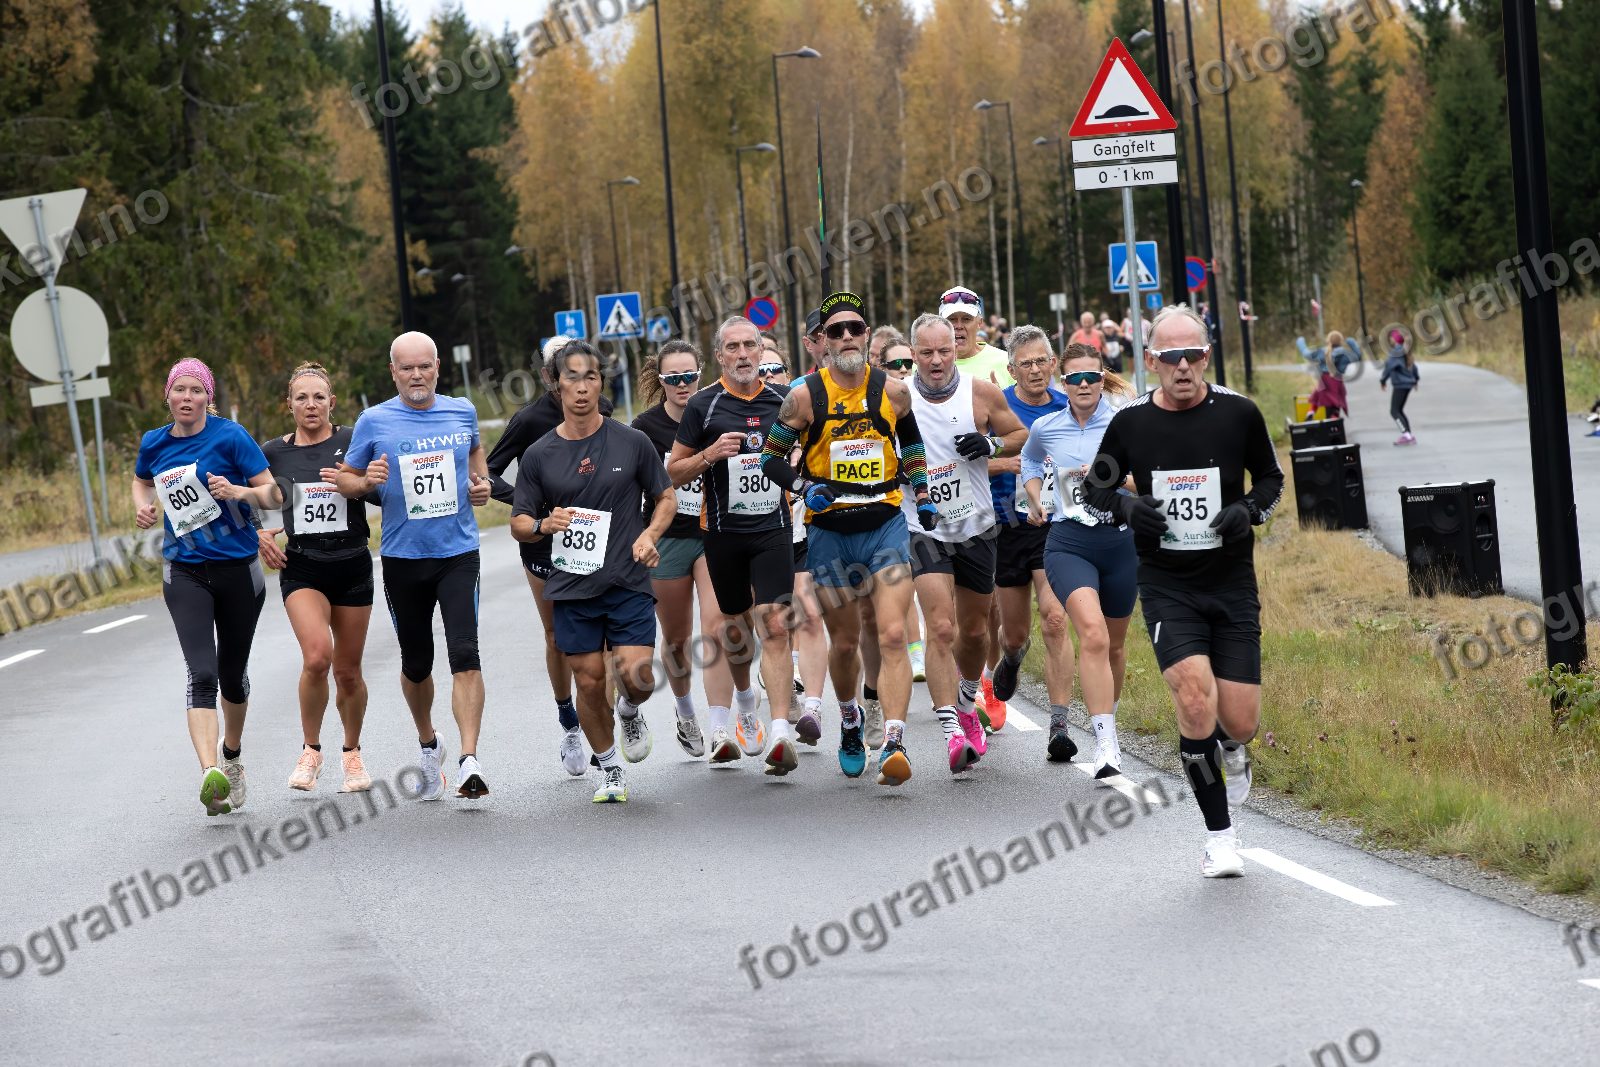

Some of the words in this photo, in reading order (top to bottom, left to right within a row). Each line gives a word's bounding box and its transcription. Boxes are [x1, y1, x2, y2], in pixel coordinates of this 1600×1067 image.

[1093, 140, 1155, 157] Gangfelt
[1098, 171, 1108, 184] 0
[1123, 169, 1128, 182] 1
[1133, 169, 1154, 181] km
[843, 442, 874, 451] NORGES
[845, 449, 869, 457] LØPET
[412, 454, 444, 464] NORGES
[415, 462, 439, 471] LØPET
[743, 463, 763, 471] LØPE
[836, 462, 880, 479] PACE
[930, 469, 954, 482] LØPET
[1167, 474, 1208, 484] NORGES
[413, 472, 446, 496] 671
[739, 474, 771, 494] 380
[929, 478, 961, 505] 697
[1170, 483, 1202, 491] LØPET
[168, 484, 200, 511] 600
[304, 503, 337, 523] 542
[1167, 497, 1209, 521] 435
[571, 512, 602, 522] ORGES
[562, 529, 598, 552] 838
